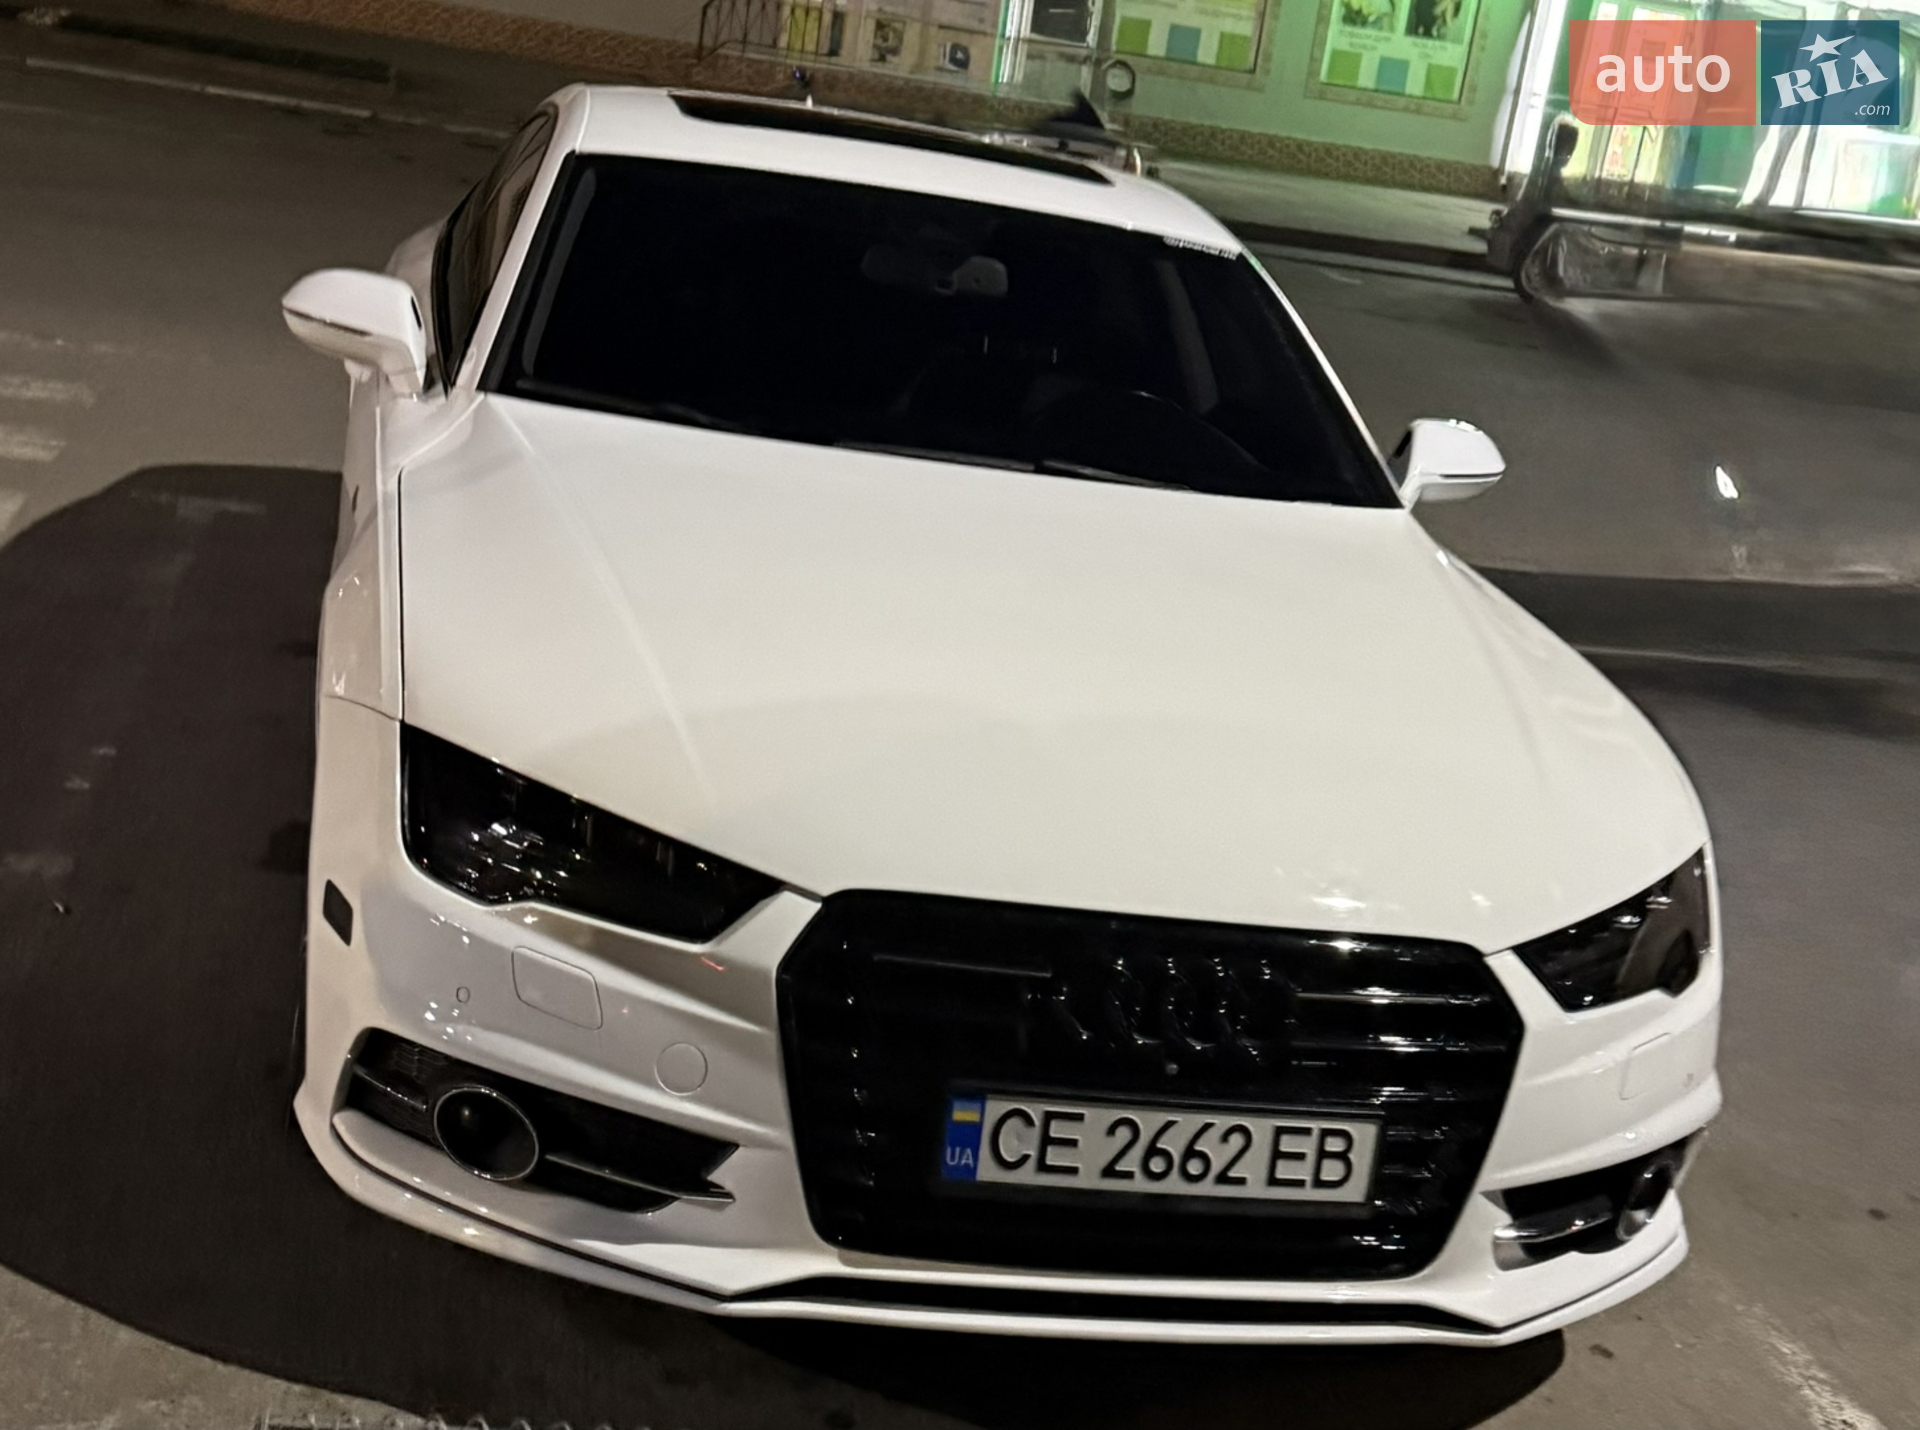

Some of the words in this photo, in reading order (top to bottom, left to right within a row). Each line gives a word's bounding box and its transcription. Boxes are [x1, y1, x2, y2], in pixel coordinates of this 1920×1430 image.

[945, 1146, 976, 1169] UA
[989, 1107, 1085, 1175] CE
[1100, 1116, 1253, 1186] 2662
[1266, 1124, 1356, 1190] EB
